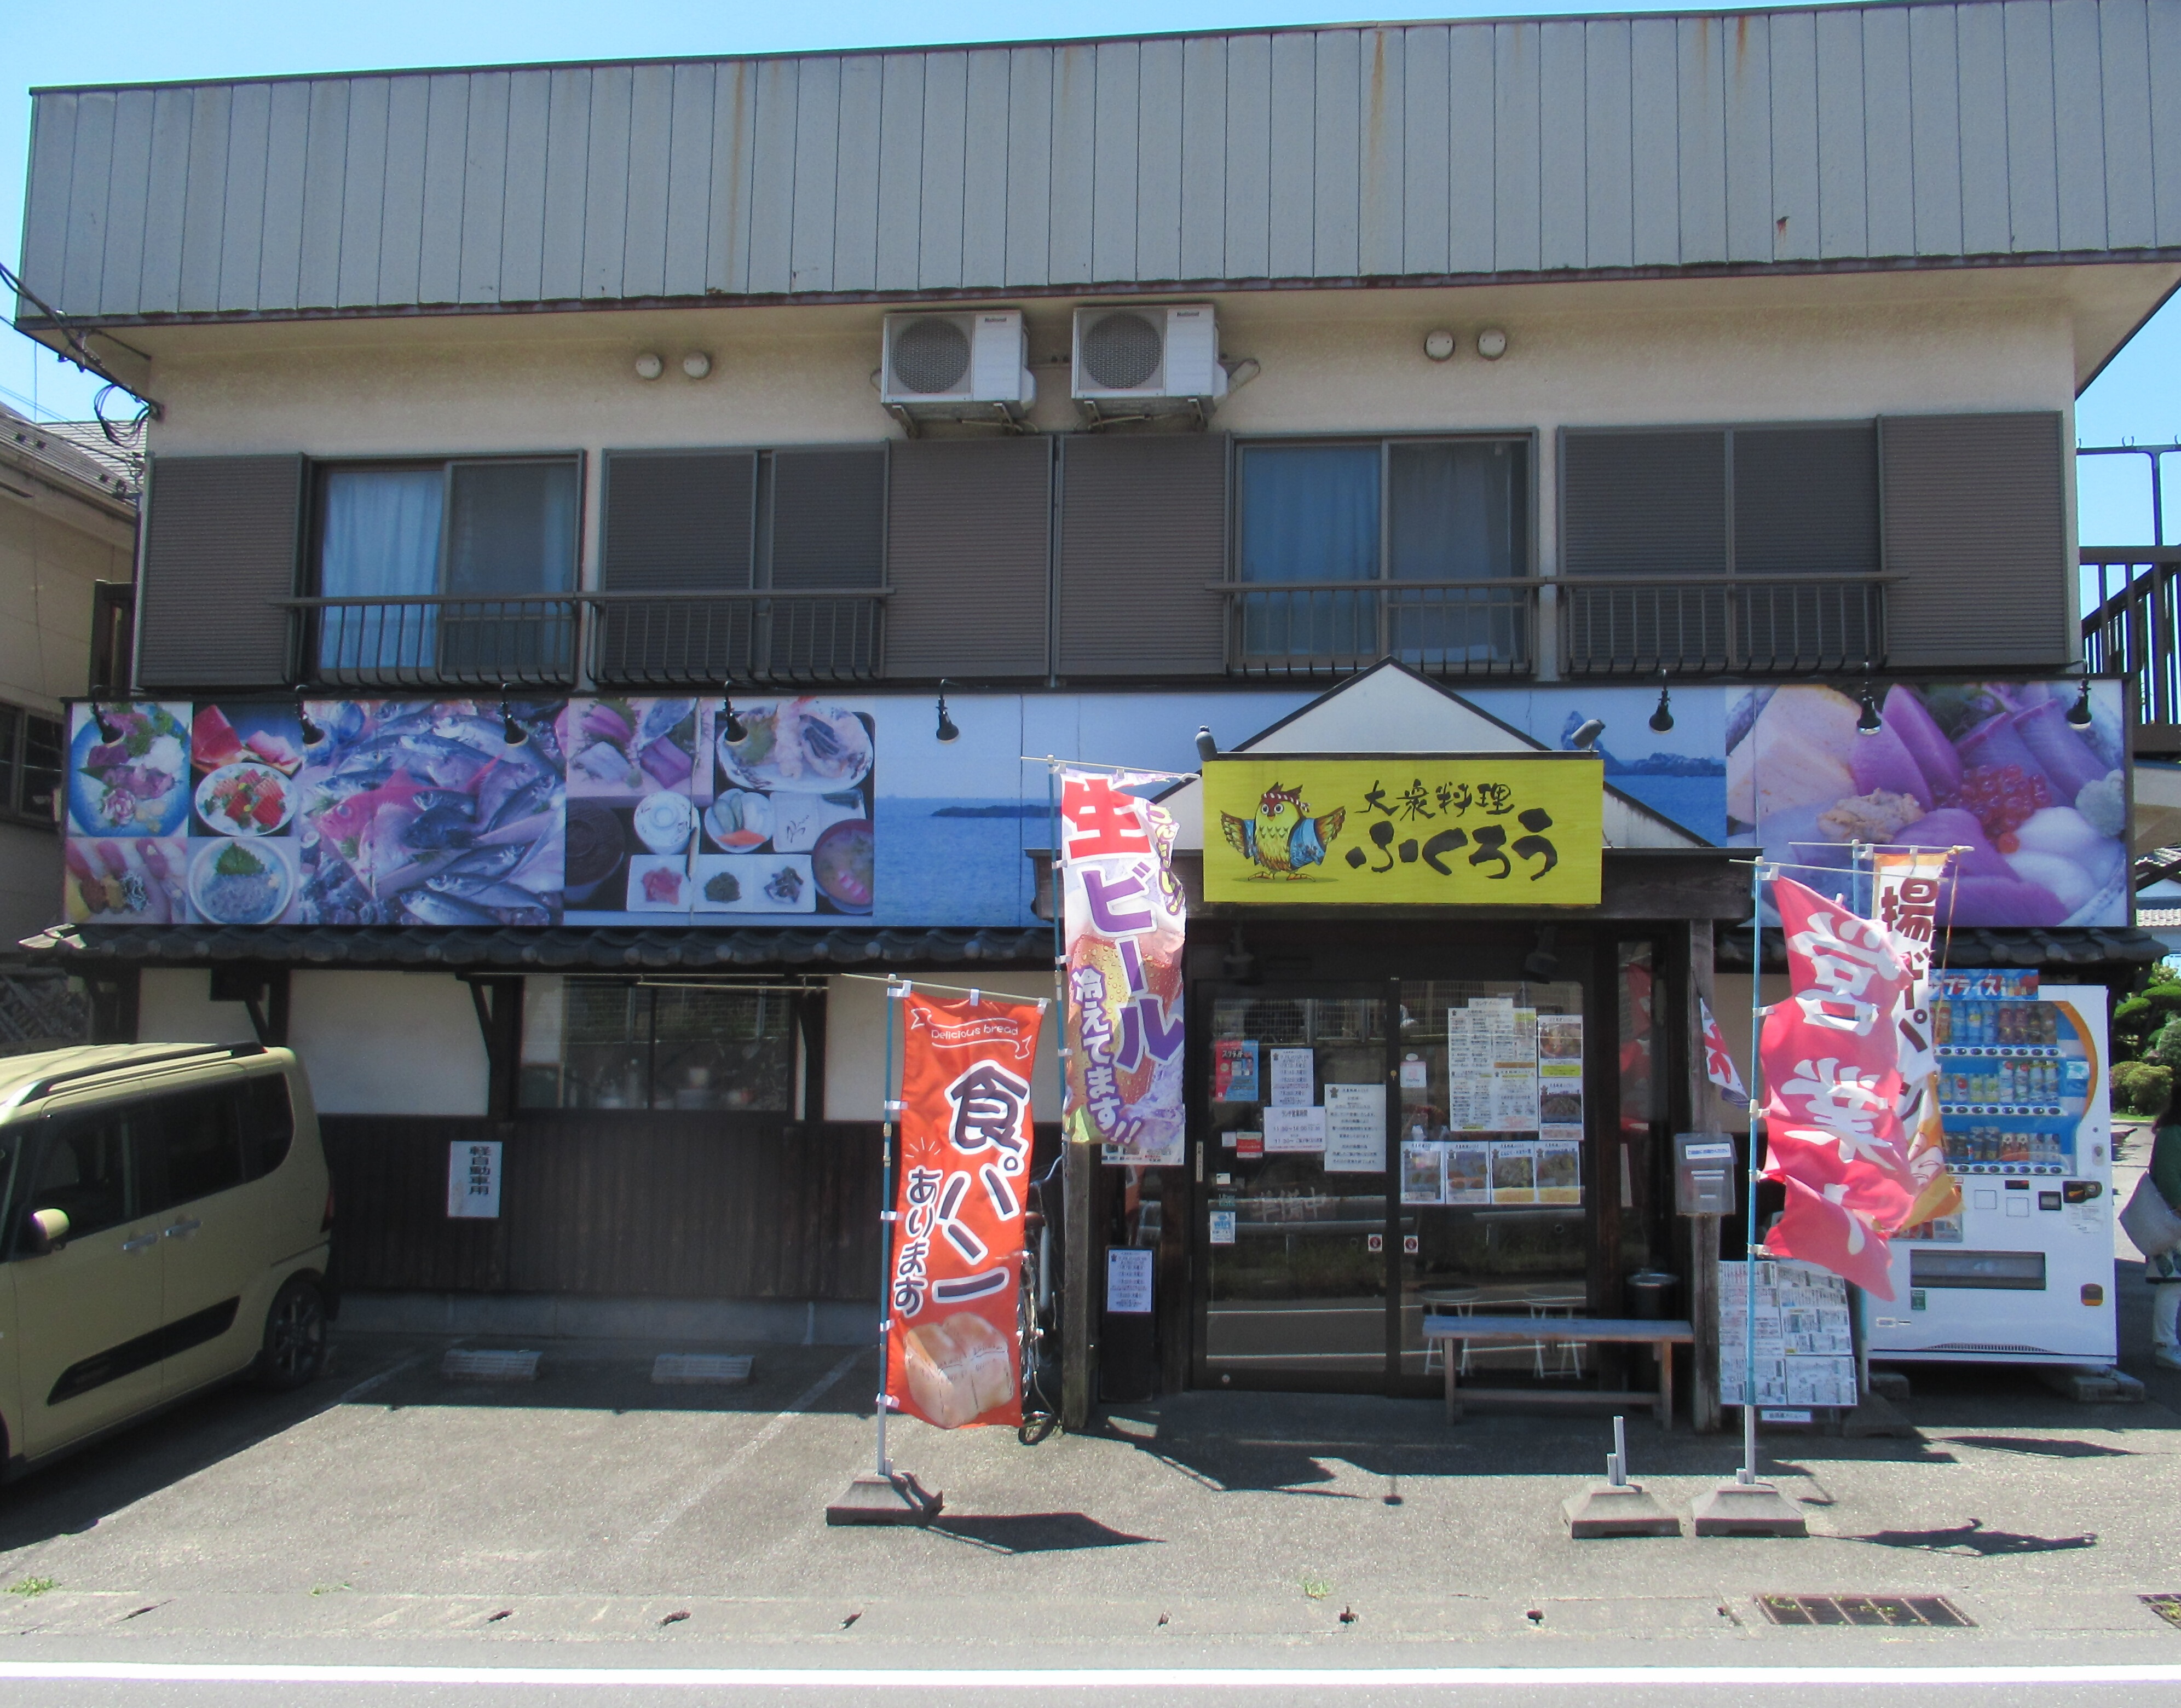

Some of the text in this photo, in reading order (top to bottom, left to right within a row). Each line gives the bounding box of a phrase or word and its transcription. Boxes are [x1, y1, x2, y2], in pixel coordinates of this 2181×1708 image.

[1345, 808, 1558, 881] ふくろう
[1354, 779, 1514, 821] 大衆料理
[1063, 778, 1184, 1073] 生ビール
[931, 1025, 1018, 1040] Delicious bread
[936, 1060, 1029, 1302] 食パン
[895, 1166, 942, 1316] あります
